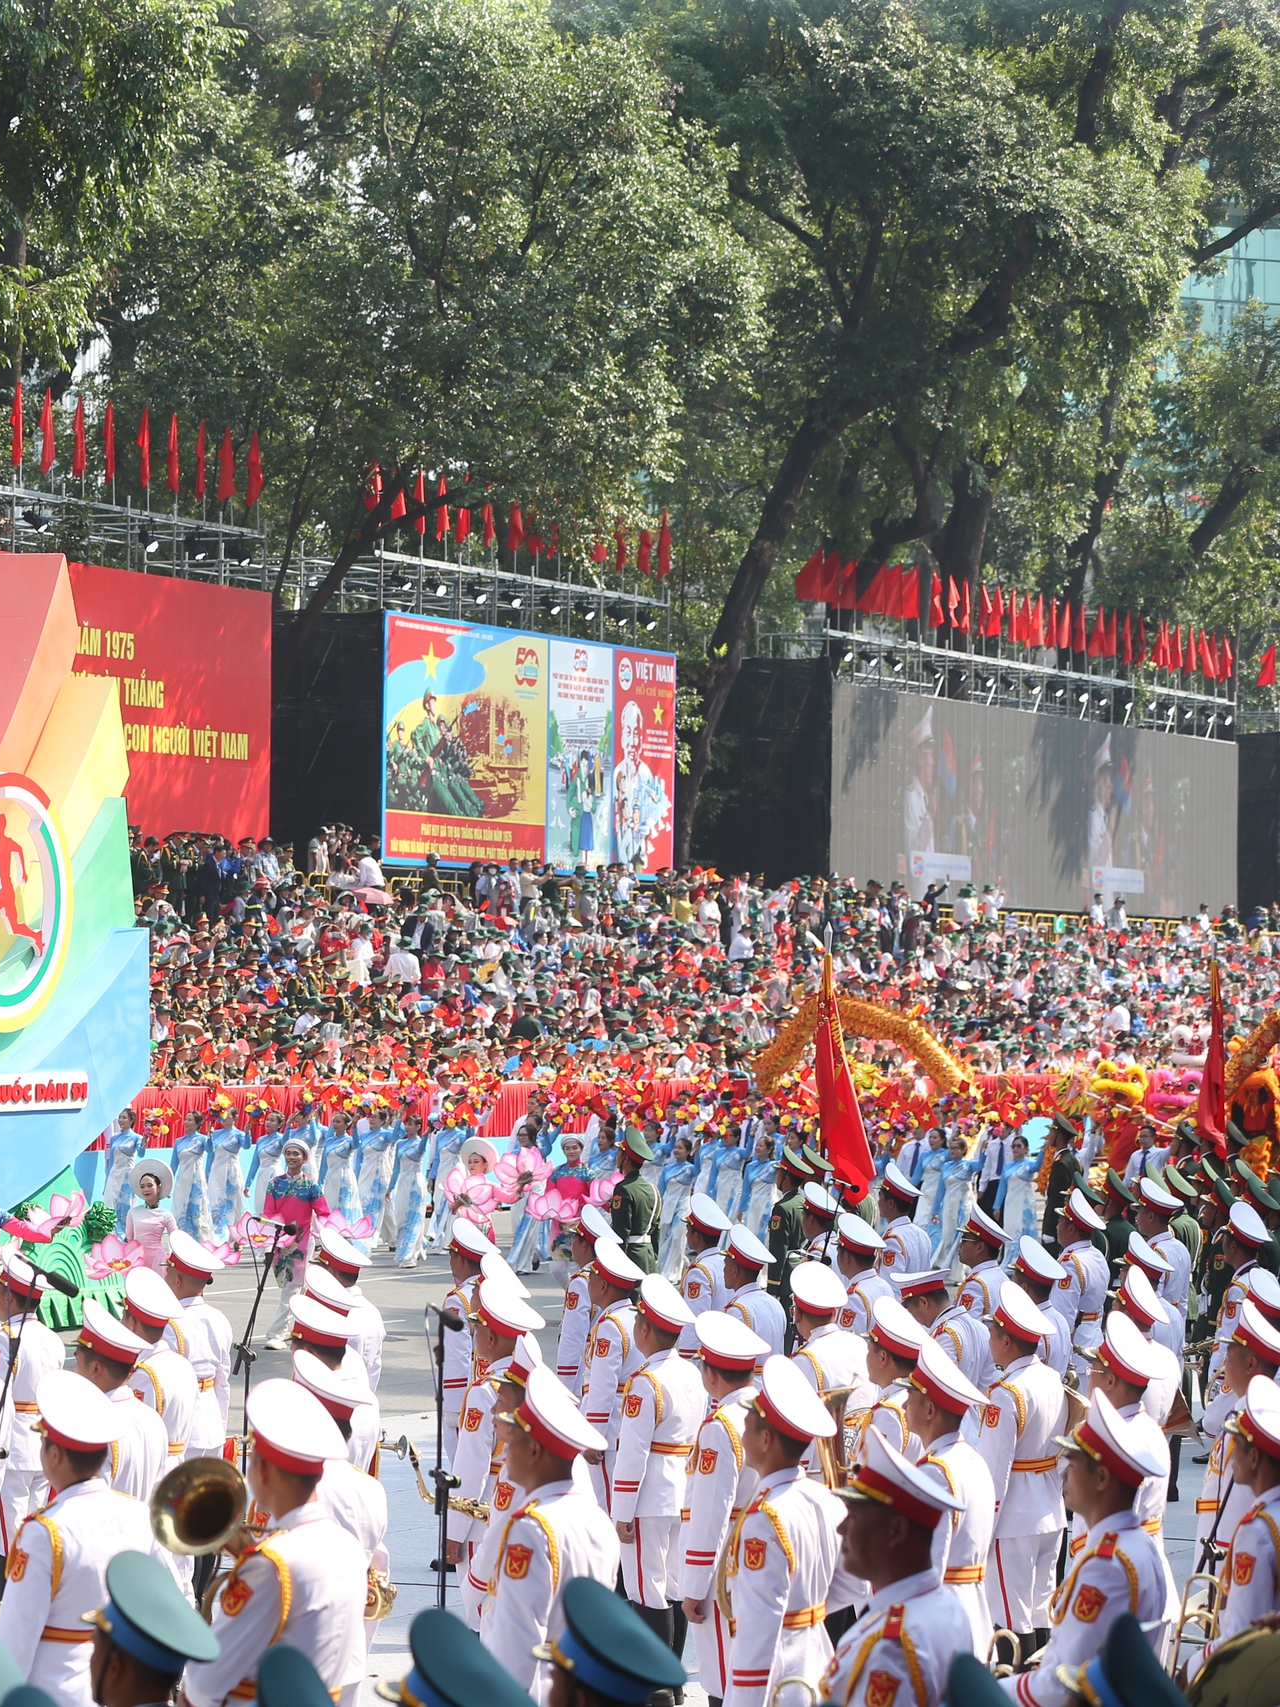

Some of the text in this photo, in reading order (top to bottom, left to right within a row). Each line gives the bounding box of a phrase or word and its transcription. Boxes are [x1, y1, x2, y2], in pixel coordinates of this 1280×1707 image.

[105, 630, 135, 660] 1975
[635, 658, 654, 684] VIỆT
[656, 664, 674, 683] NAM
[124, 669, 165, 709] THẮNG
[658, 689, 673, 699] MINH
[124, 722, 248, 763] CON NGƯỜI VIỆT NAM
[71, 1082, 88, 1100] ĐI
